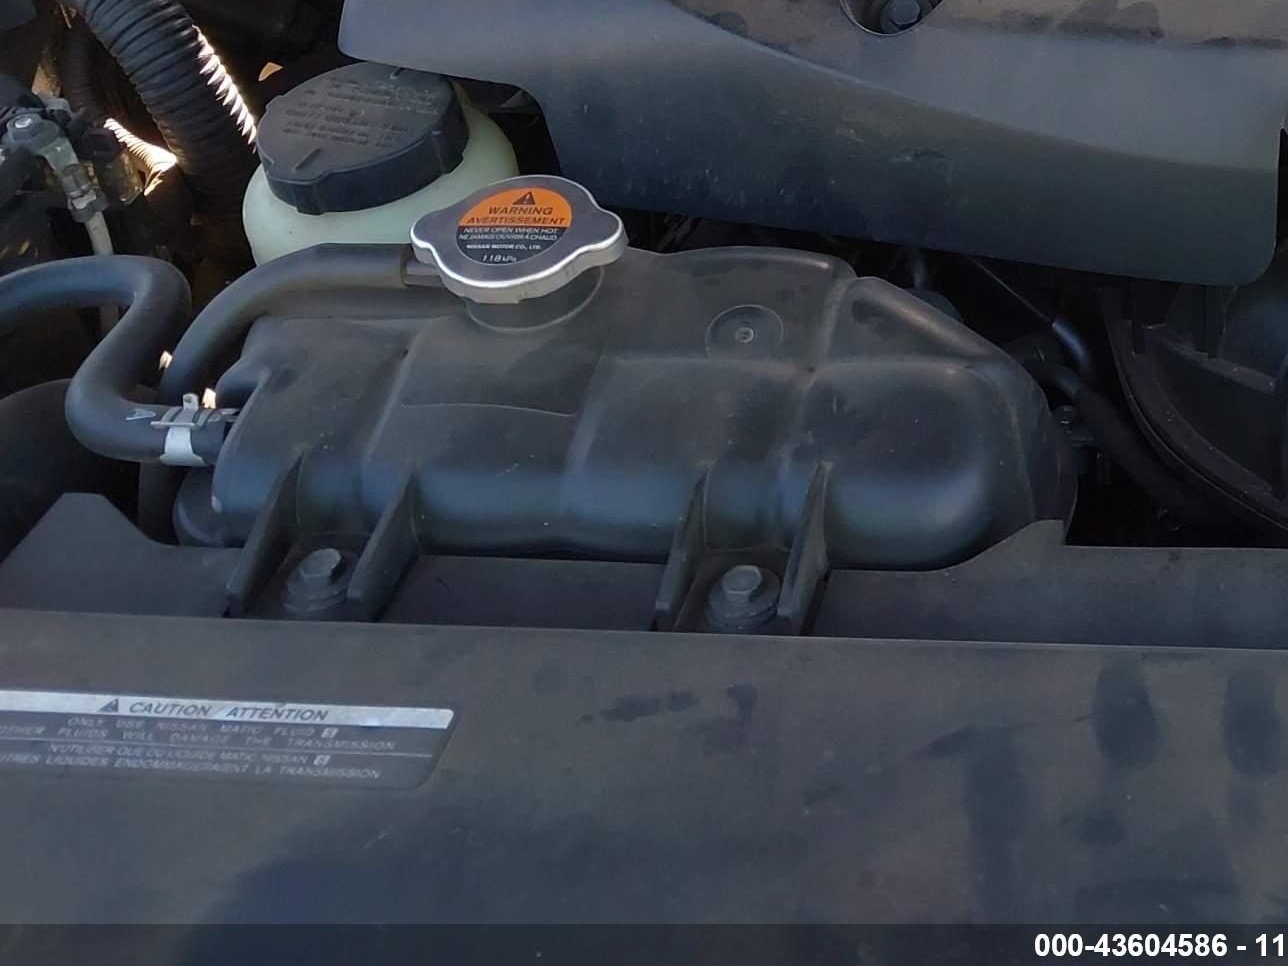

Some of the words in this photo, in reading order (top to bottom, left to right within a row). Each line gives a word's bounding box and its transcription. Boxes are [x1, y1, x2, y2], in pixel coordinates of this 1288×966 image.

[488, 206, 554, 216] WARNING
[466, 217, 565, 226] AVERTISSEMENT
[129, 702, 213, 716] CAUTION
[226, 707, 329, 721] ATTENTION
[67, 716, 104, 727] ONLY
[116, 719, 145, 729] USE
[155, 721, 208, 731] NISSAN
[219, 724, 263, 735] MATIC
[57, 727, 109, 738] FLUIDS
[122, 730, 153, 739] WILL
[245, 736, 273, 746] THE
[287, 738, 396, 750] TRANSMISSION
[280, 766, 383, 779] TRANSMISSION
